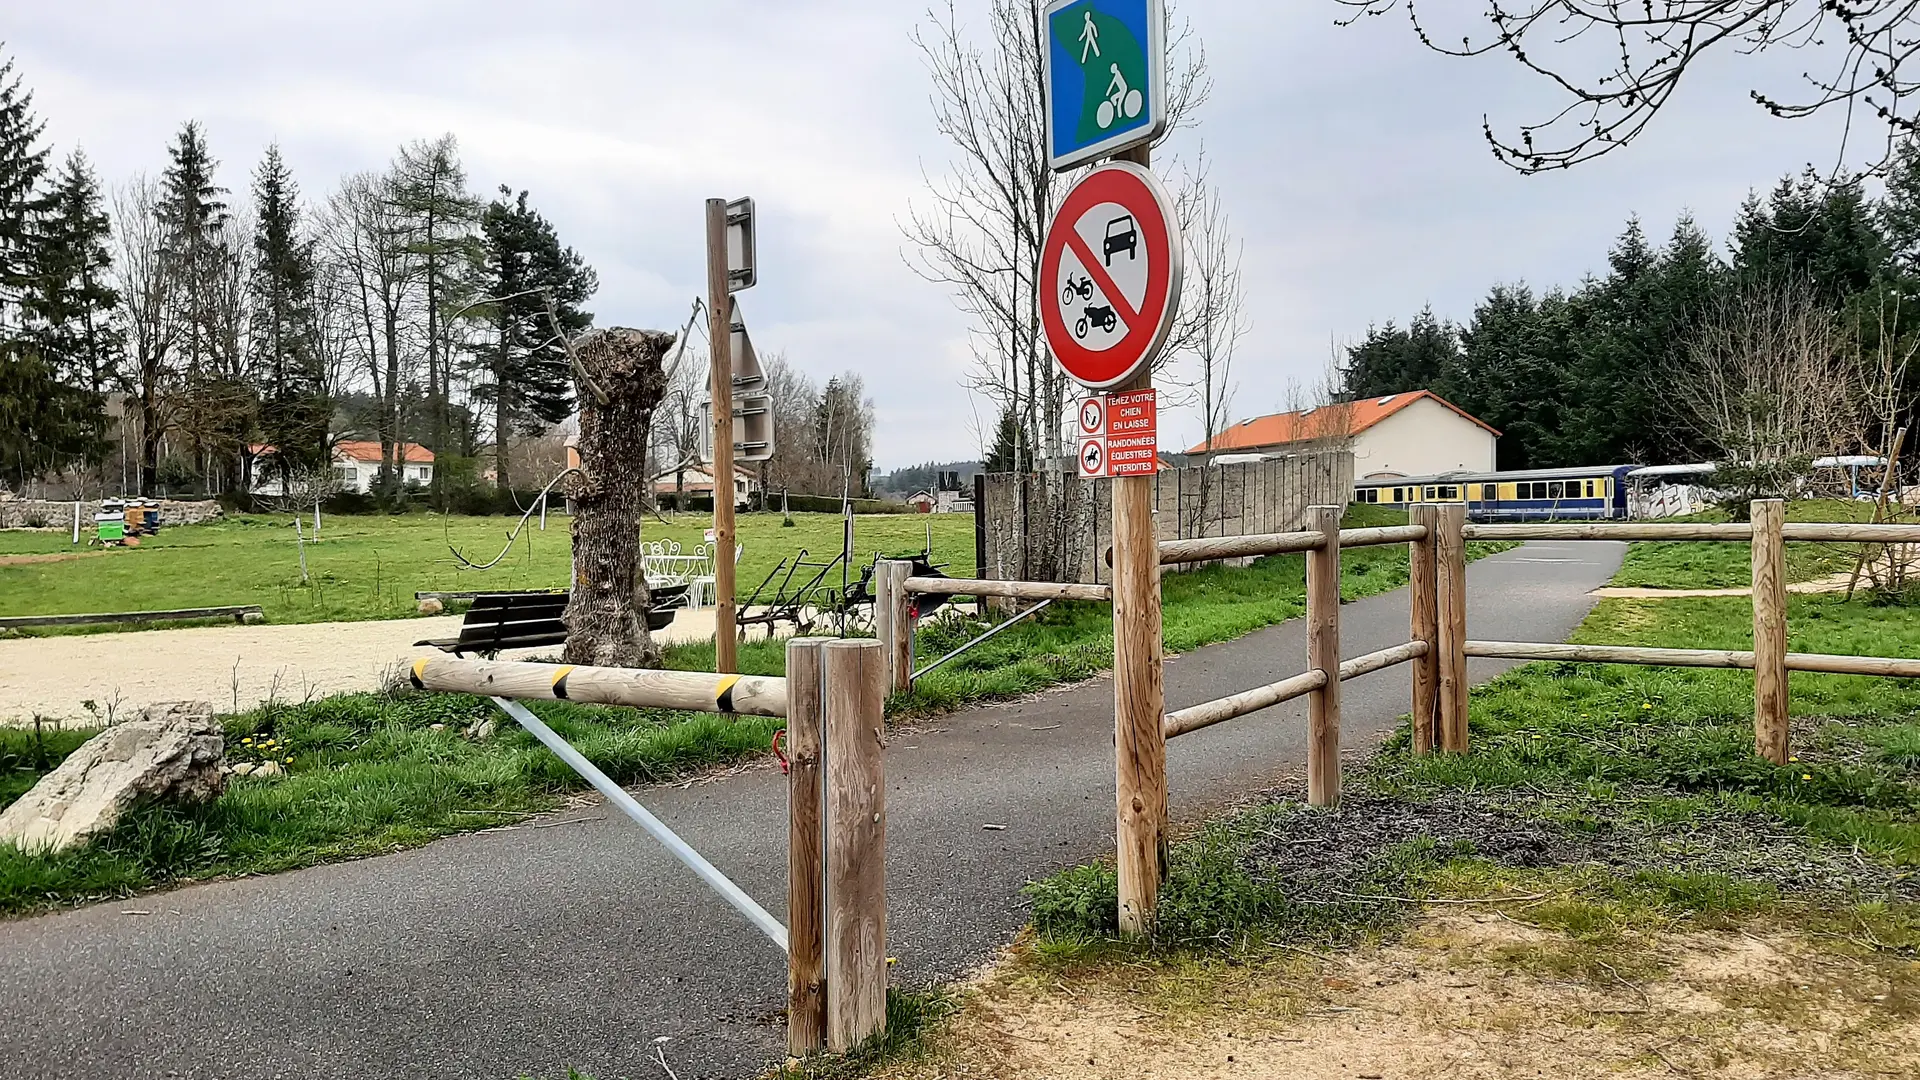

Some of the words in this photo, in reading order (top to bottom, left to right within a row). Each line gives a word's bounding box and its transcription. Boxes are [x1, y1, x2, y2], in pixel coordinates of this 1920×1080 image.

[1107, 395, 1129, 406] TENEZ
[1130, 392, 1154, 403] VOTRE
[1120, 407, 1141, 417] CHIEN
[1113, 421, 1123, 430] EN
[1124, 418, 1149, 429] LAISSE
[1108, 436, 1155, 449] RANDONNÉES
[1111, 449, 1152, 460] ÉQUESTRES
[1112, 462, 1151, 473] INTERDITES
